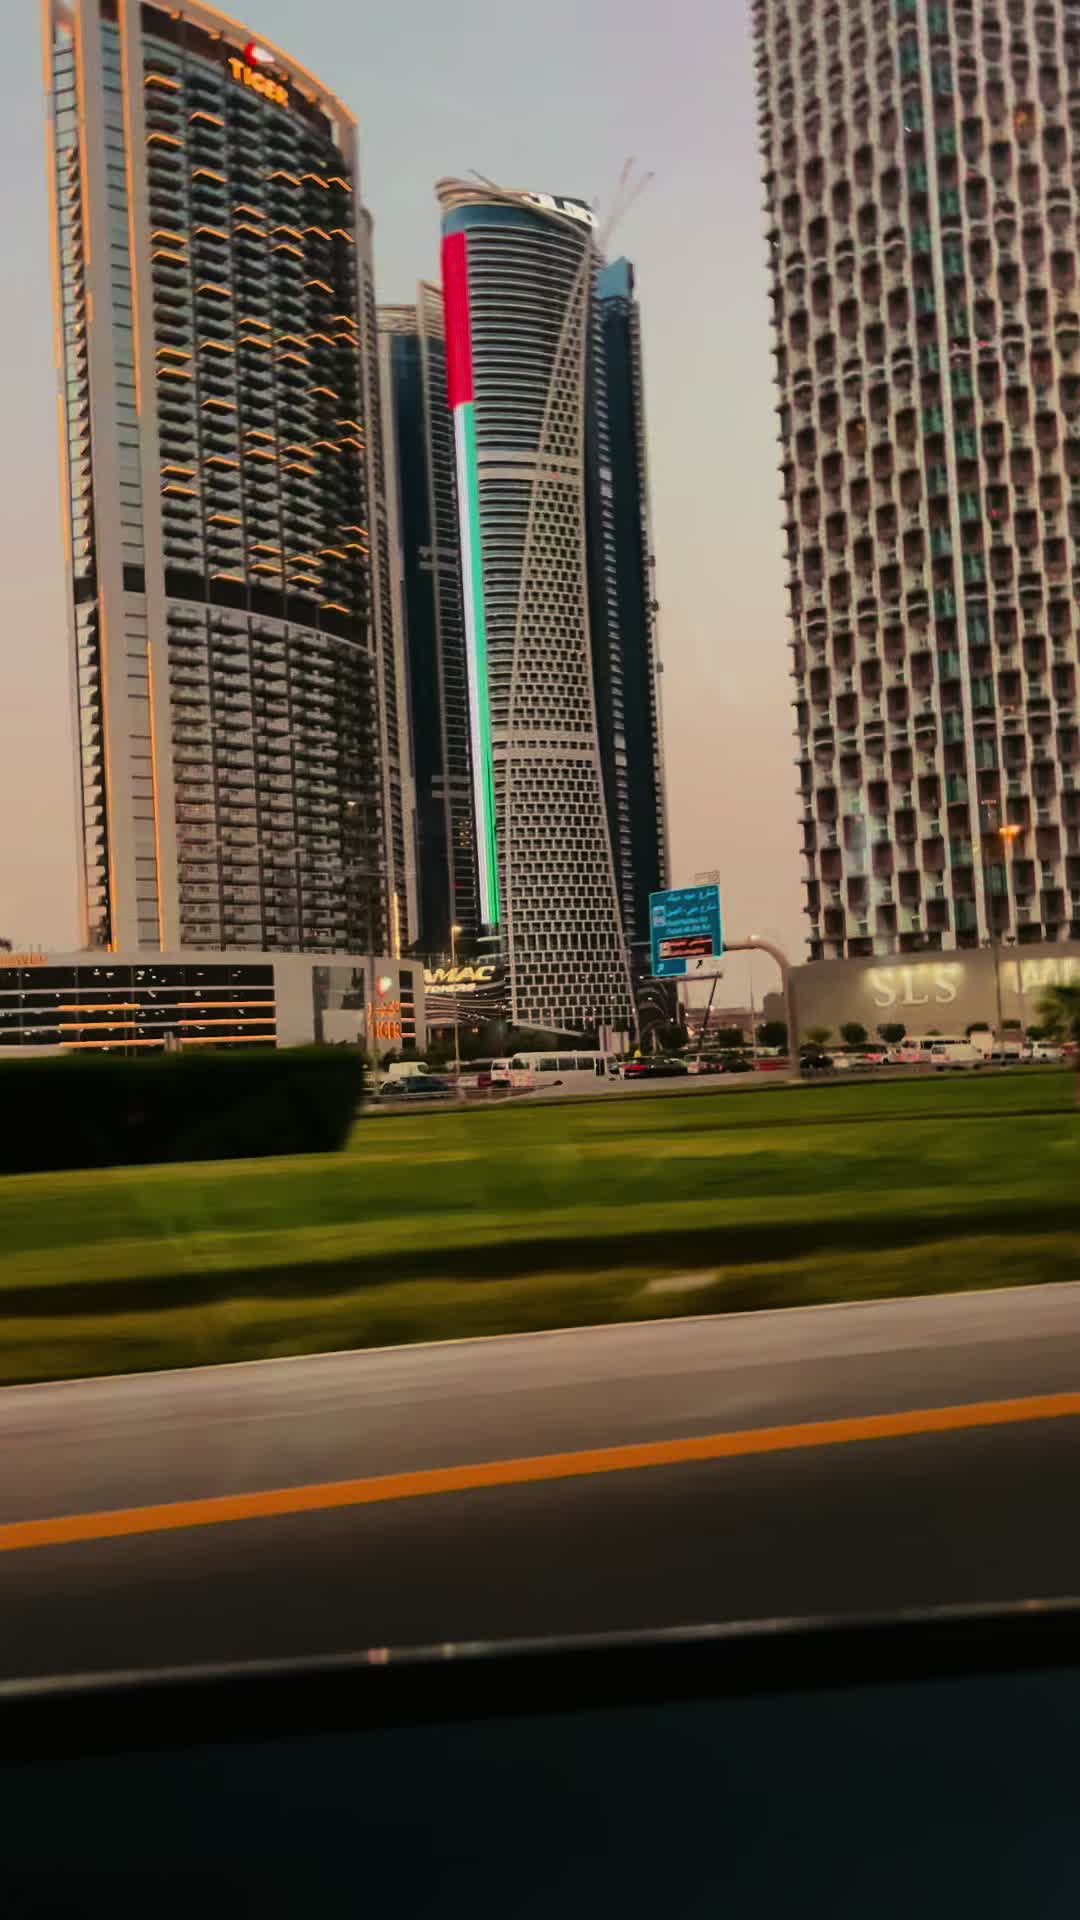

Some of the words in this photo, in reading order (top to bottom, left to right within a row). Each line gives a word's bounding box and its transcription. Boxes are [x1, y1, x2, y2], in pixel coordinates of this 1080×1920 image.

[228, 56, 289, 110] TIGER
[423, 965, 496, 983] AMAC
[871, 963, 957, 1008] SLS
